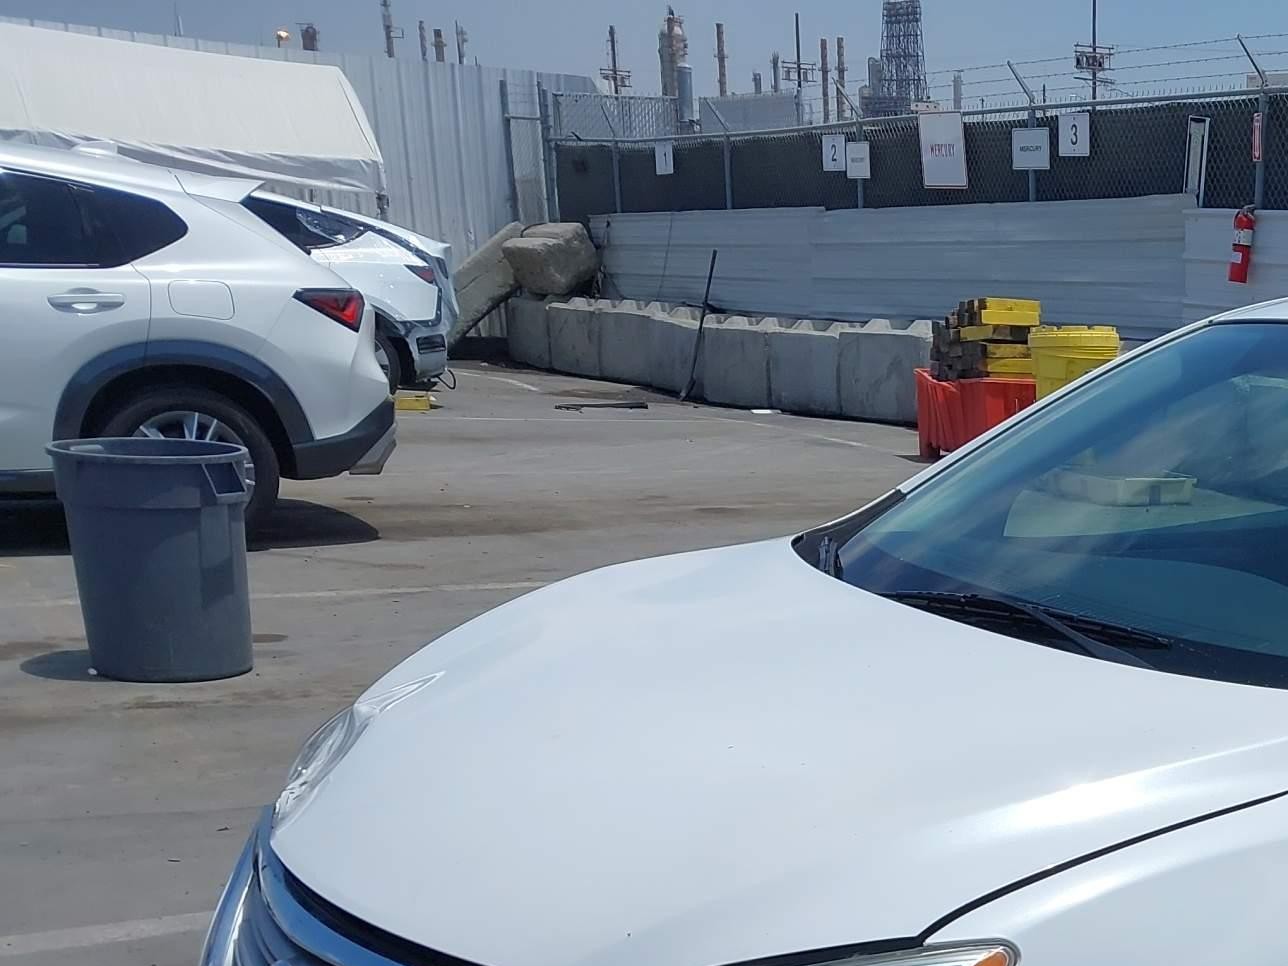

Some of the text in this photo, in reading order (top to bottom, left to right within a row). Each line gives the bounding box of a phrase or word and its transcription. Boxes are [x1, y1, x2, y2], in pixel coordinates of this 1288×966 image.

[1070, 123, 1078, 146] 3
[663, 151, 667, 166] 1
[830, 144, 838, 162] 2
